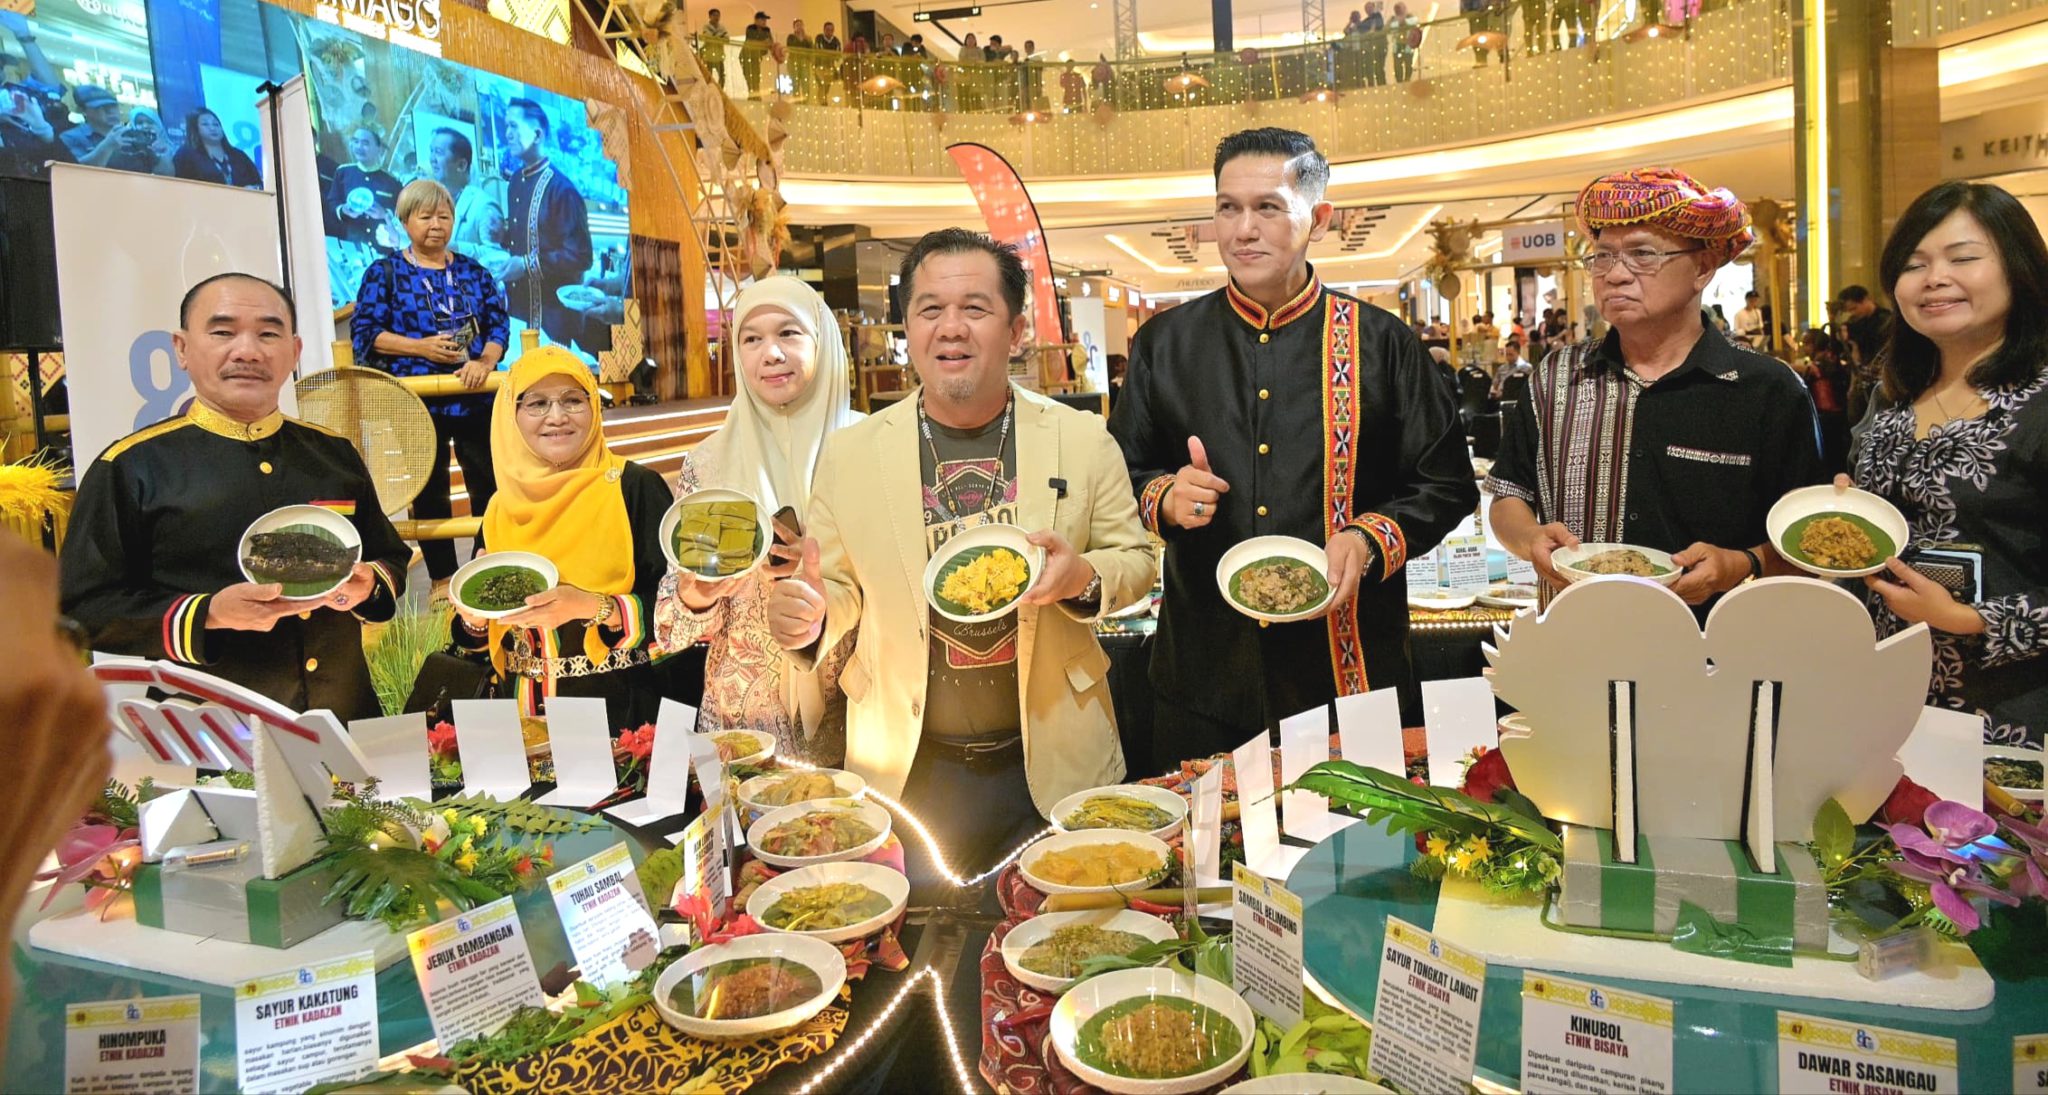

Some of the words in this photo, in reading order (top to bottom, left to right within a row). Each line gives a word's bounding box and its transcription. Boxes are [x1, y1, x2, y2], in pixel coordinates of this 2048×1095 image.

[1522, 234, 1555, 248] UOB
[954, 619, 1007, 636] Brussels
[570, 885, 594, 905] TUHAU
[595, 871, 624, 893] SAMBAL
[582, 898, 597, 912] ETNIK
[1239, 890, 1263, 915] SAMBAL
[1265, 905, 1297, 935] BELIMBING
[427, 948, 456, 970] JERUK
[457, 924, 514, 957] BAMBANGAN
[448, 960, 469, 973] ETNIK
[470, 944, 501, 964] KADAZAN
[1386, 947, 1411, 970] SAYUR
[1414, 959, 1448, 987] TONGKAT
[1450, 977, 1478, 1003] LANGIT
[1535, 983, 1544, 992] 46
[256, 999, 294, 1019] SAYUR
[299, 985, 358, 1010] KAKATUNG
[1408, 974, 1426, 992] ETNIK
[1427, 983, 1450, 1004] BISAYA
[275, 1014, 299, 1029] ETNIK
[302, 1005, 342, 1023] KADAZAN
[1571, 1015, 1624, 1042] KINUBOL
[99, 1029, 166, 1049] HINOMPUKA
[1565, 1032, 1591, 1049] ETNIK
[1594, 1038, 1629, 1058] BISAYA
[100, 1050, 123, 1062] ETNIK
[126, 1047, 165, 1060] KADAZAN
[1528, 1061, 1550, 1071] masak
[1552, 1066, 1568, 1077] yang
[1528, 1050, 1560, 1064] Diperbuat
[1566, 1059, 1595, 1072] daripada
[1600, 1068, 1636, 1081] campuran
[1640, 1077, 1665, 1089] pisang
[1528, 1071, 1545, 1082] parut
[1575, 1081, 1588, 1090] dan
[1799, 1052, 1850, 1077] DAWAR
[1856, 1062, 1936, 1092] SASANGAU
[1830, 1078, 1860, 1095] ETNIK
